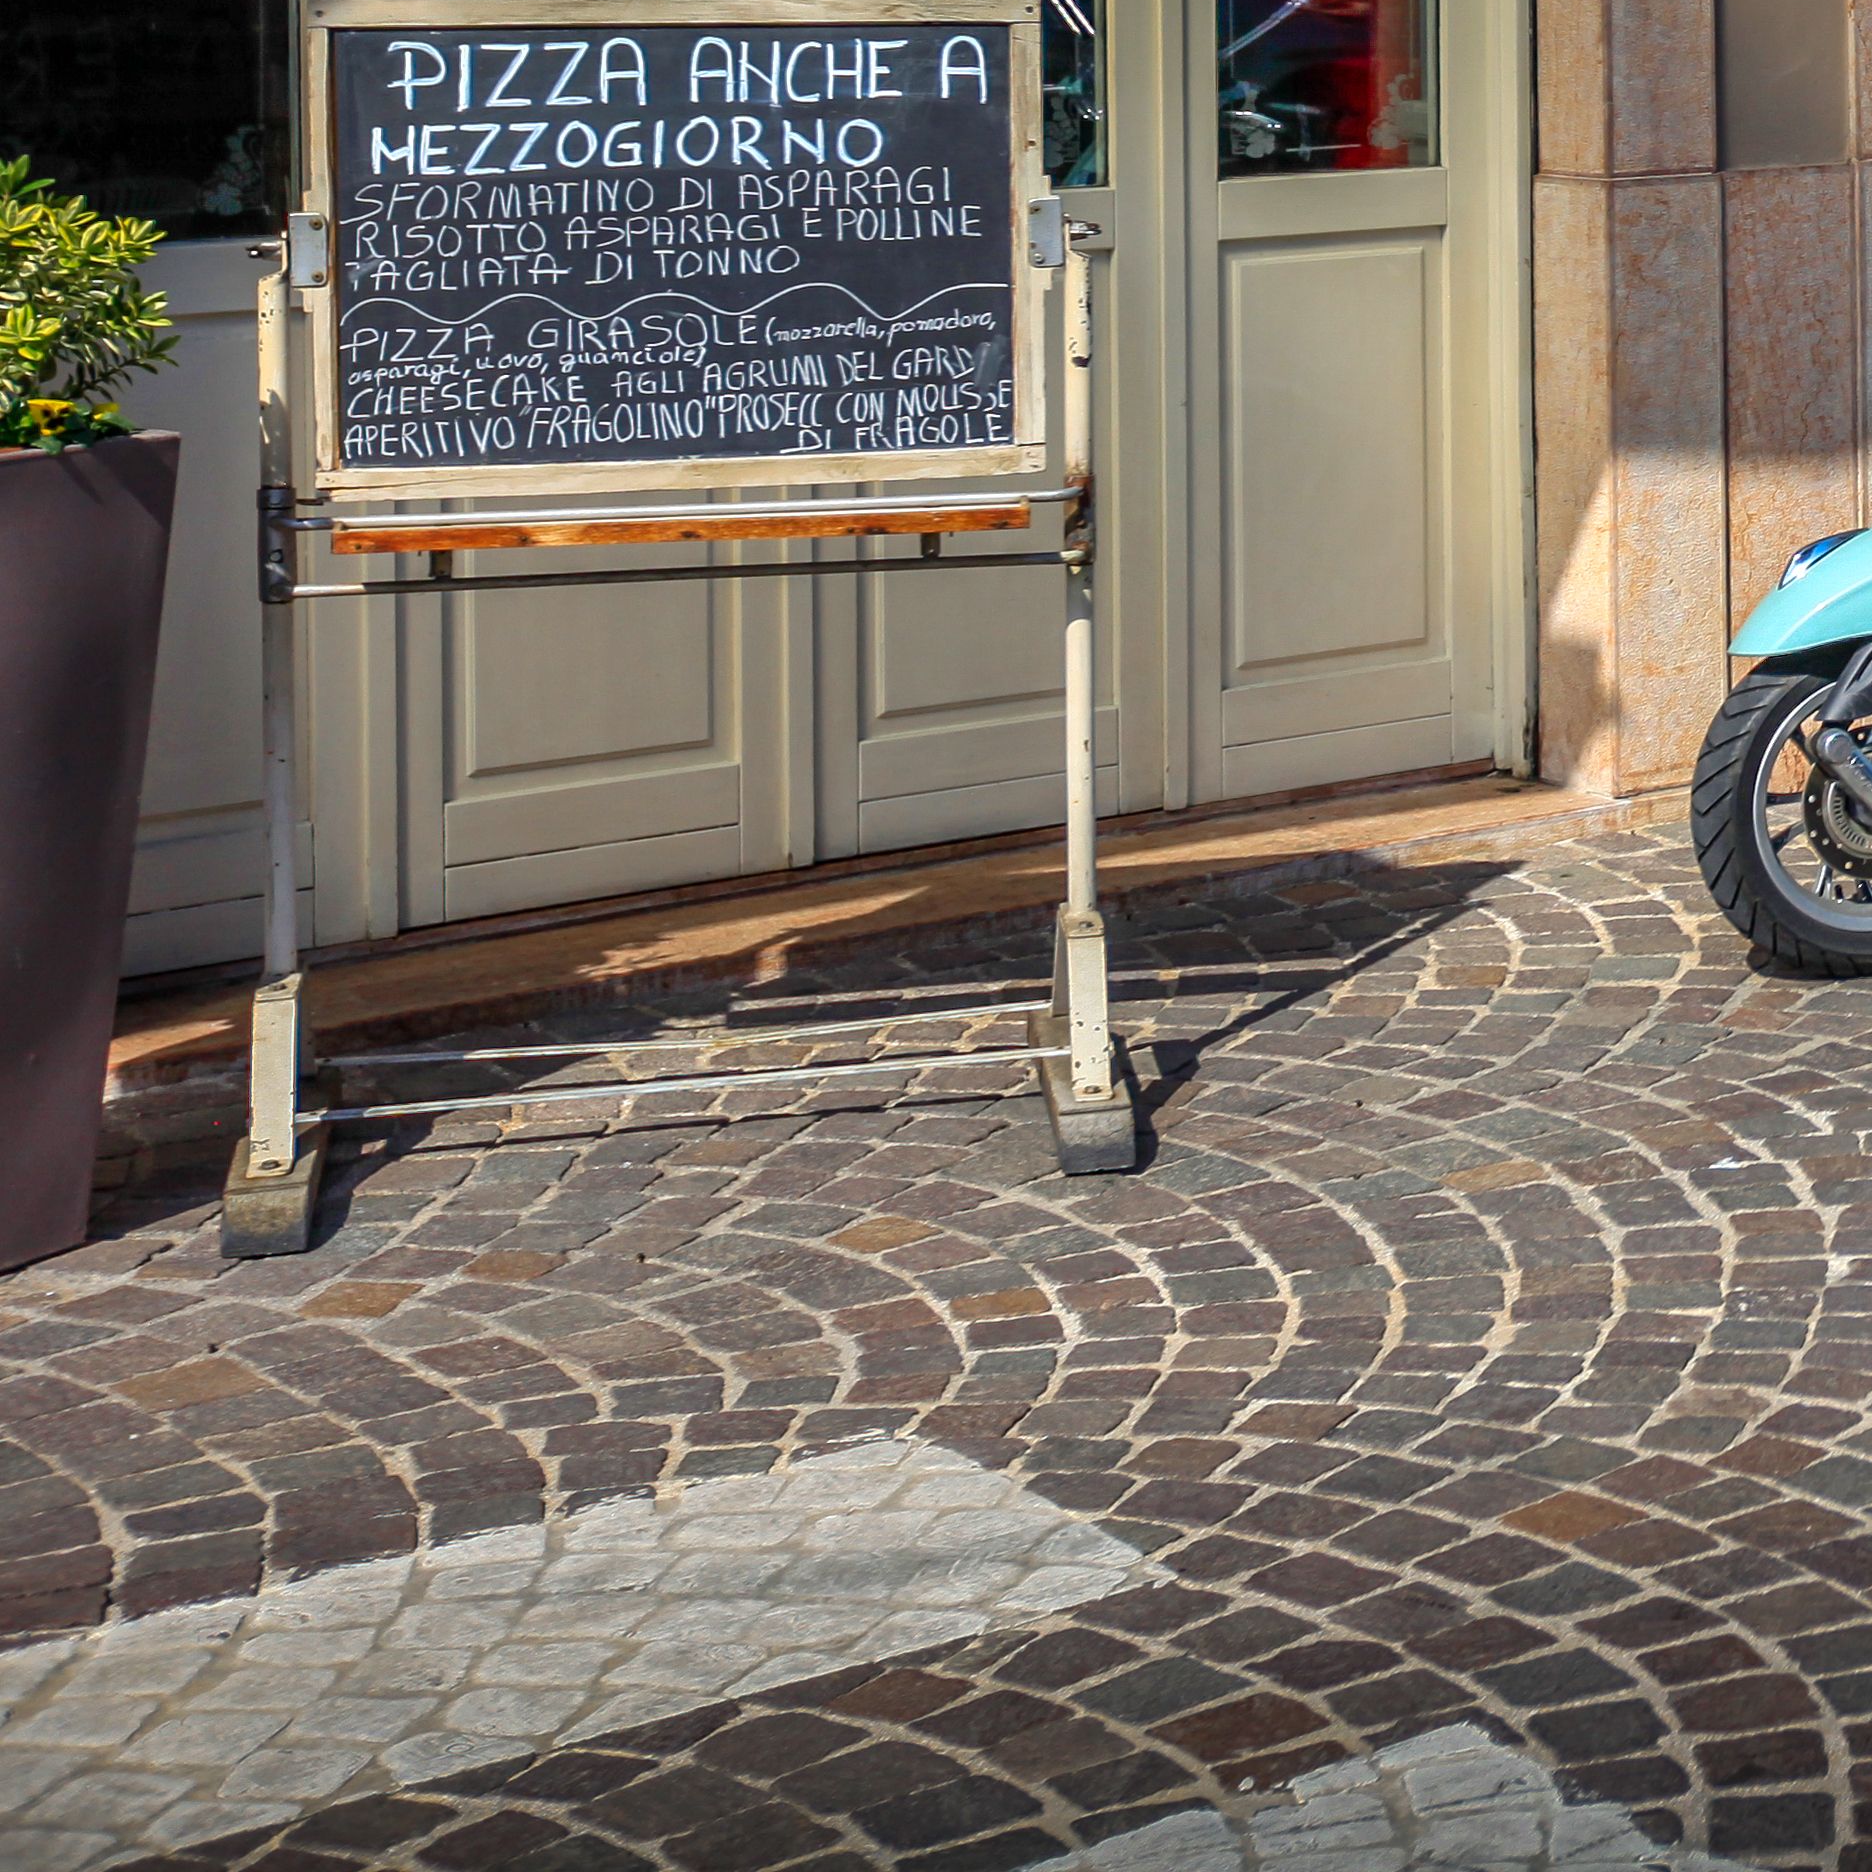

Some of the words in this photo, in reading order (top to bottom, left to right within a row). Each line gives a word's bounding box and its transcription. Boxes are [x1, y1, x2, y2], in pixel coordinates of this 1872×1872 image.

[386, 37, 648, 112] PIZZA
[689, 36, 909, 108] ANCHE
[941, 35, 988, 105] A
[370, 115, 884, 176] MEZZOGIORNO
[339, 178, 655, 225] SFORMATINO
[667, 177, 714, 213] DI
[738, 166, 951, 210] ASPARAGI
[354, 221, 547, 259] RISOTTO
[563, 213, 780, 251] ASPARAGI
[801, 207, 823, 238] E
[837, 205, 983, 242] POLLINE
[344, 253, 573, 292] TAGLIATA
[584, 251, 634, 286] DI
[652, 245, 800, 279] TONNO
[339, 322, 496, 363] PIZZA
[527, 313, 759, 350] GIRASOLE
[347, 374, 590, 419] CHEESECAKE
[610, 371, 686, 399] AGLI
[702, 354, 828, 394] AGRUMI
[835, 350, 885, 387] DEL
[343, 415, 516, 460] APERITIVO
[835, 390, 885, 424] CON
[779, 428, 832, 455] DI
[855, 414, 1010, 451] FRAGOLE
